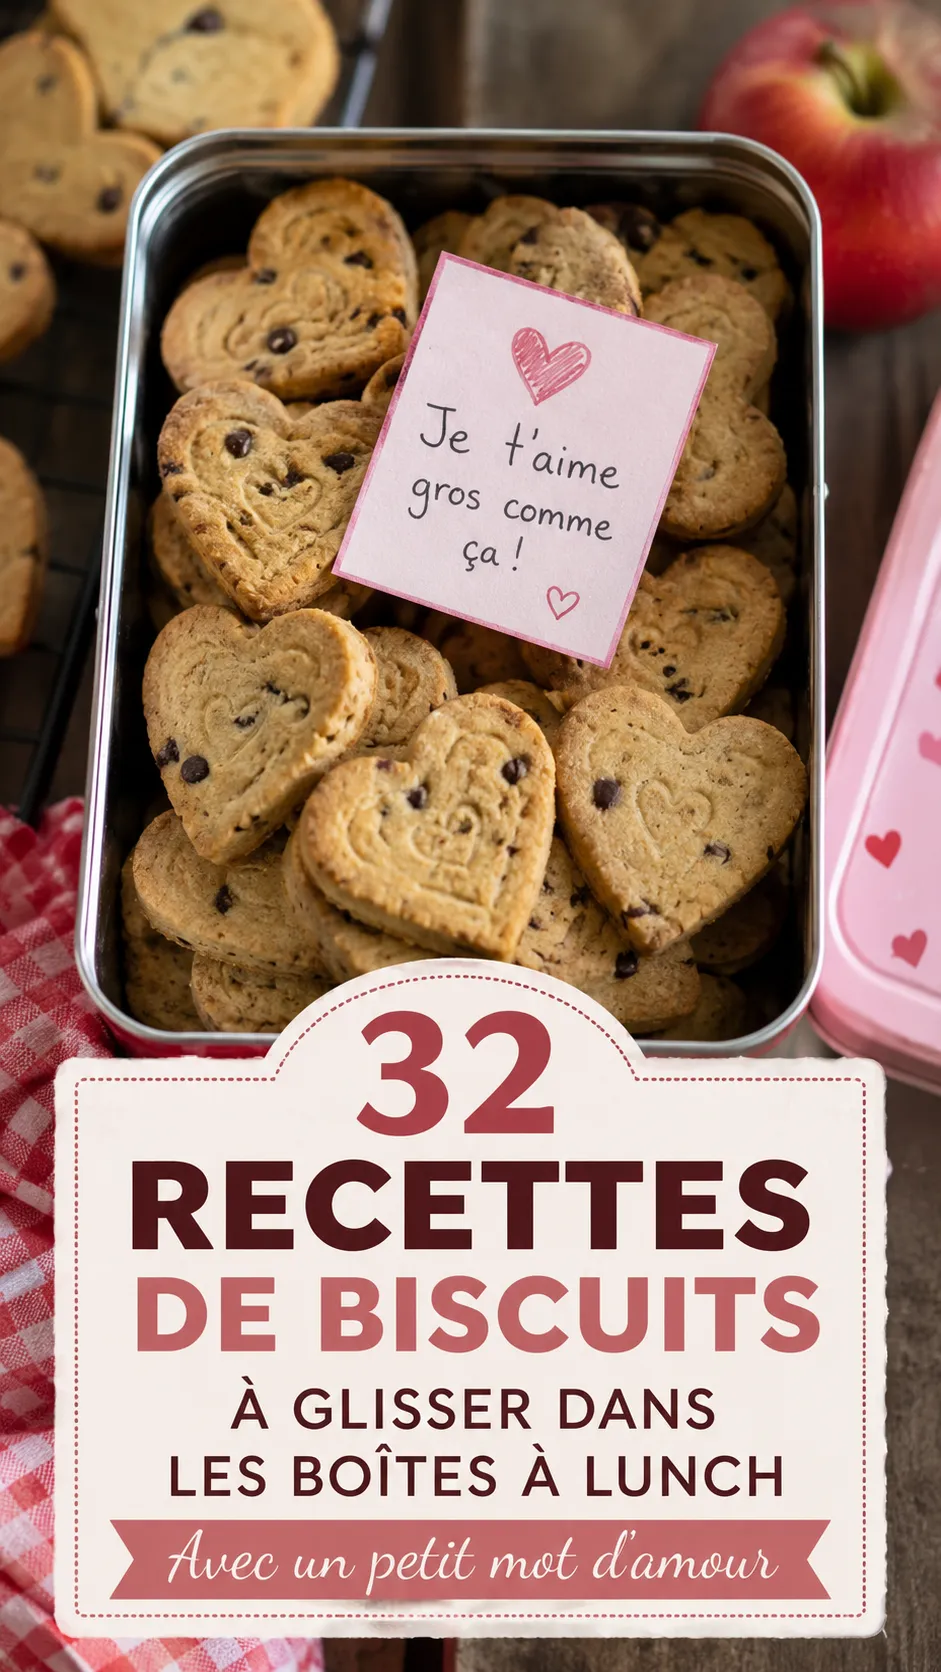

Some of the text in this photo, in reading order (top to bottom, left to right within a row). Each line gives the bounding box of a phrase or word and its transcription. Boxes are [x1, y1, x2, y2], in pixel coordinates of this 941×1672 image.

[419, 402, 620, 490] Je t'aime
[407, 478, 613, 541] gros comme
[462, 535, 524, 573] ça !
